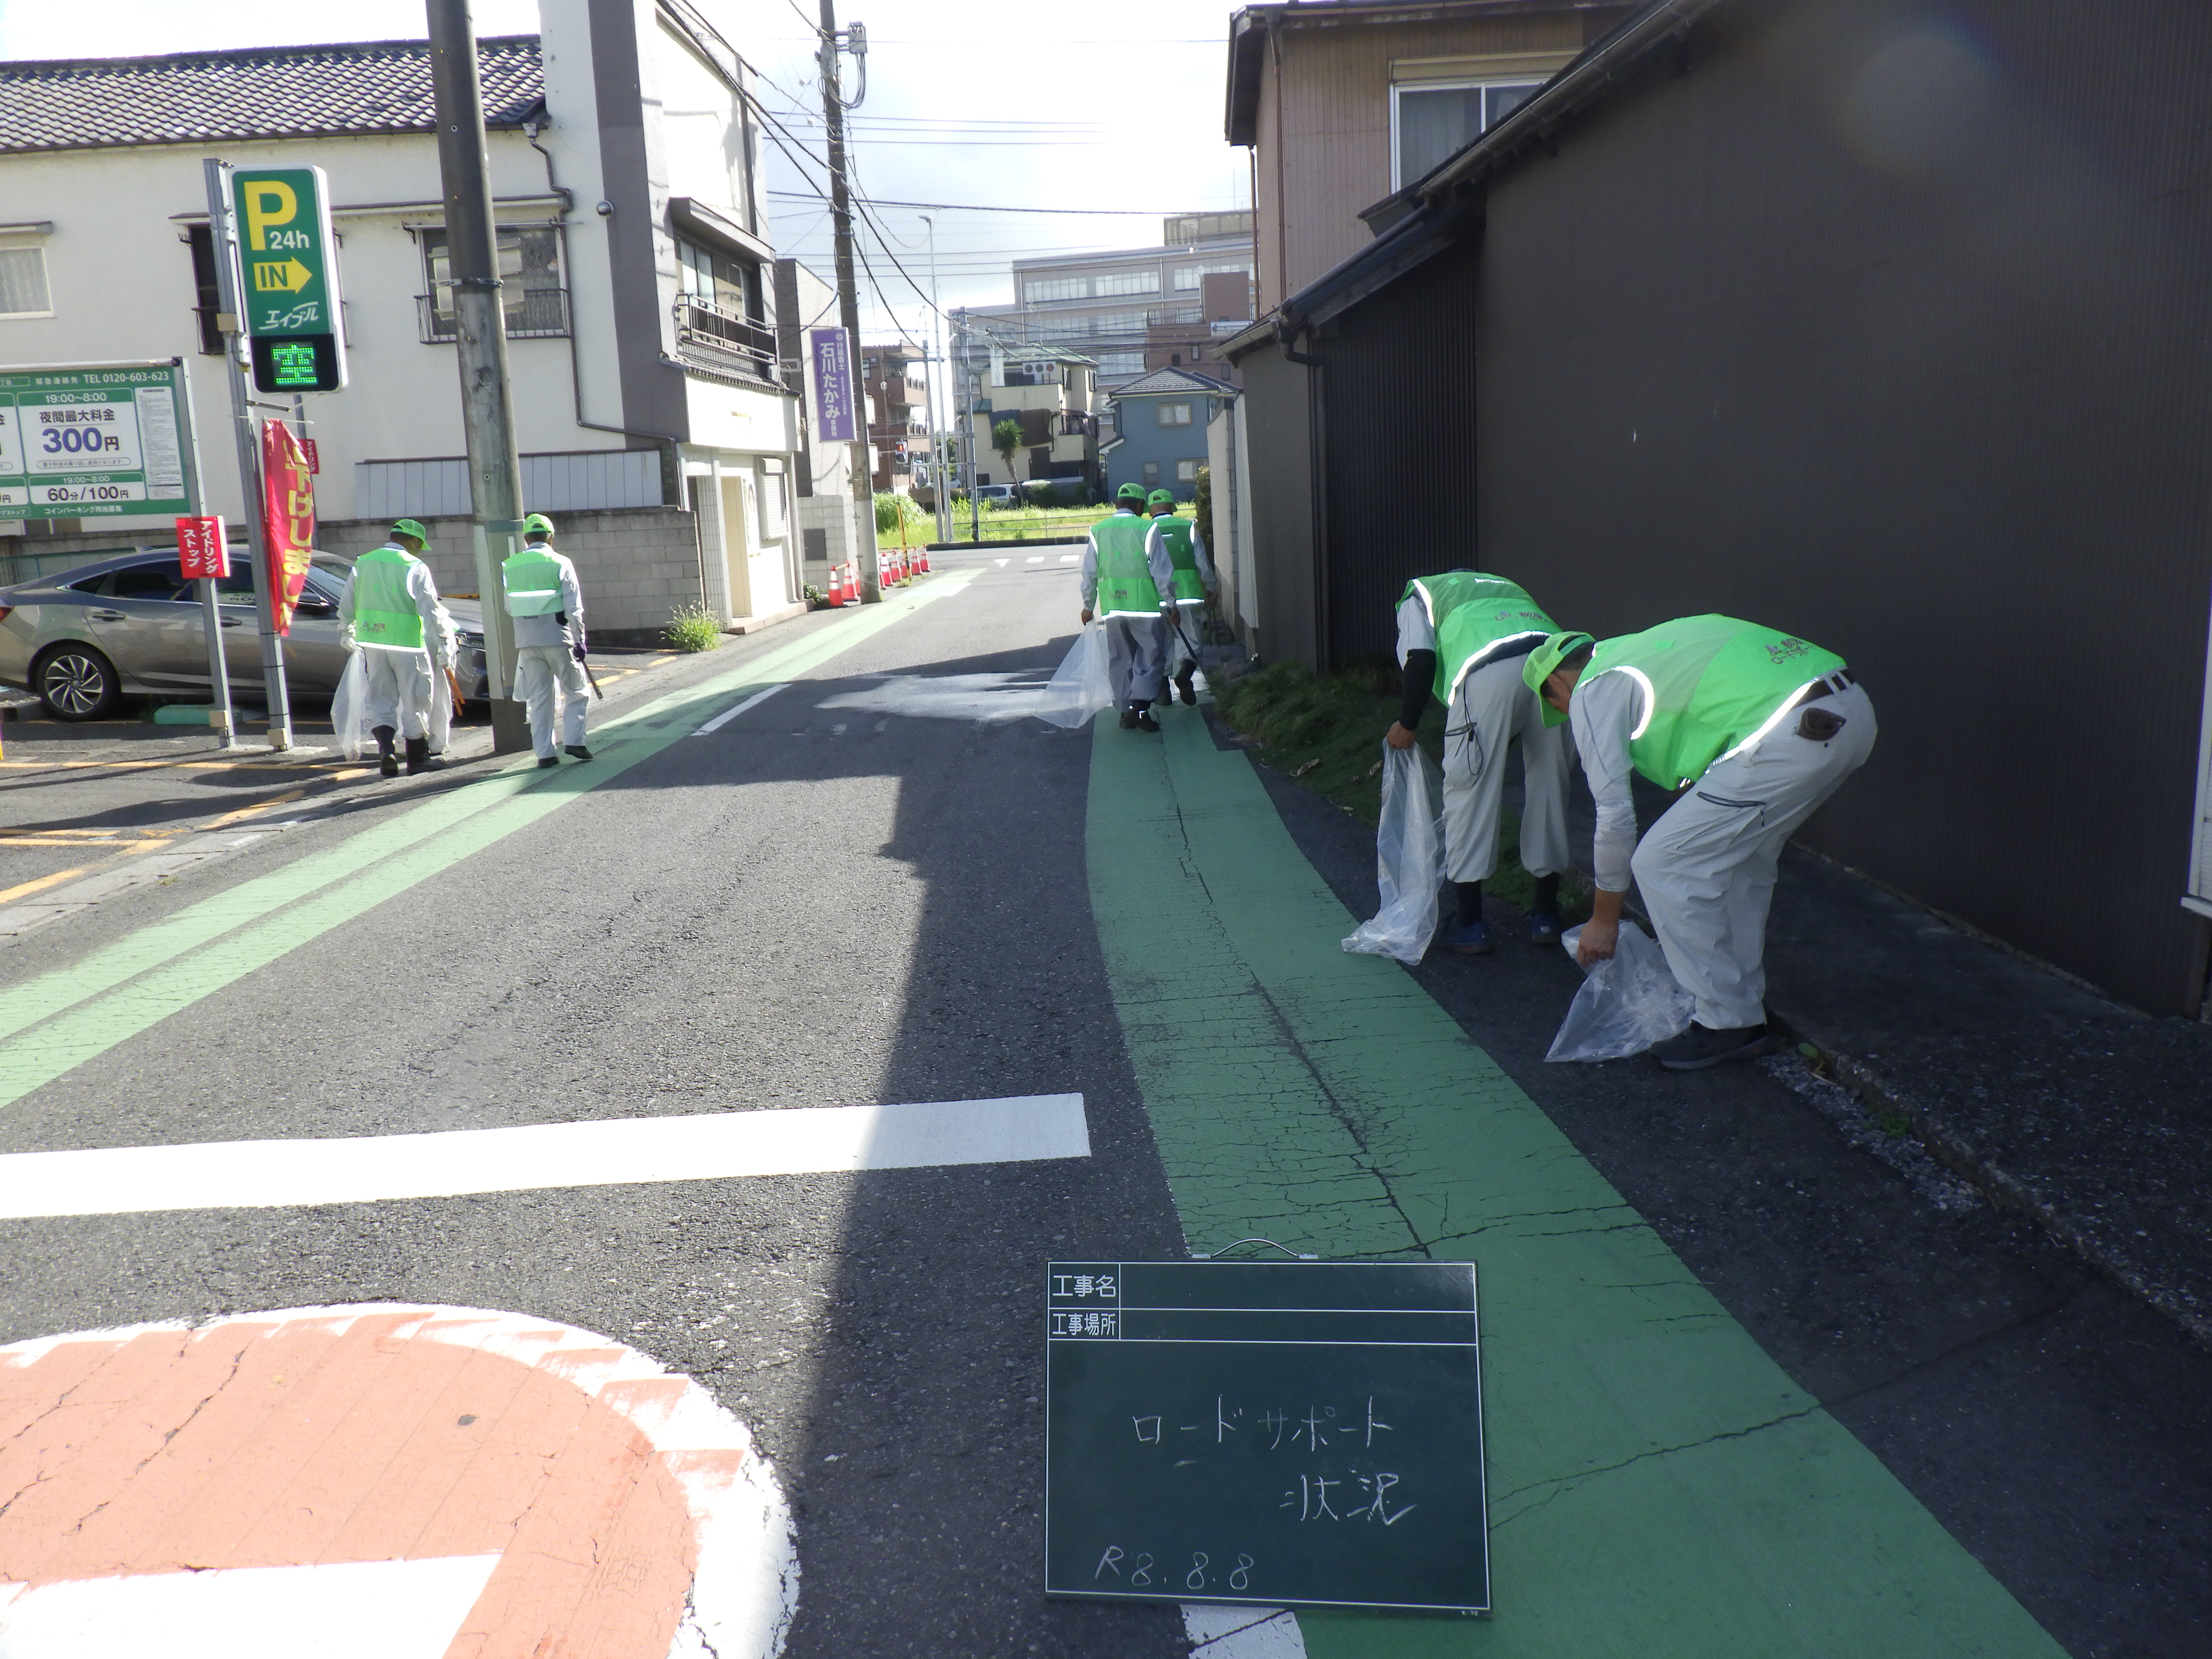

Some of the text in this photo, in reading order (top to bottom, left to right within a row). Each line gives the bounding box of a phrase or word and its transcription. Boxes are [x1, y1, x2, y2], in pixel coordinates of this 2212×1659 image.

[244, 180, 297, 251] P
[269, 230, 310, 250] 24h
[259, 264, 288, 288] IN
[259, 301, 319, 330] エイブル
[271, 343, 317, 385] 空
[83, 374, 101, 384] TEL
[102, 372, 169, 383] 0120-603-623
[39, 408, 116, 424] 夜間最大料金
[43, 427, 120, 453] 300円
[0, 493, 12, 504] 円
[47, 486, 129, 502] 60分/100円
[183, 529, 201, 568] ストップ
[199, 520, 219, 574] アイドリング
[1052, 1274, 1117, 1298] 工事名
[1052, 1313, 1117, 1336] 工事場所
[1132, 1394, 1394, 1452] ロードサポート
[1279, 1468, 1417, 1526] 状況
